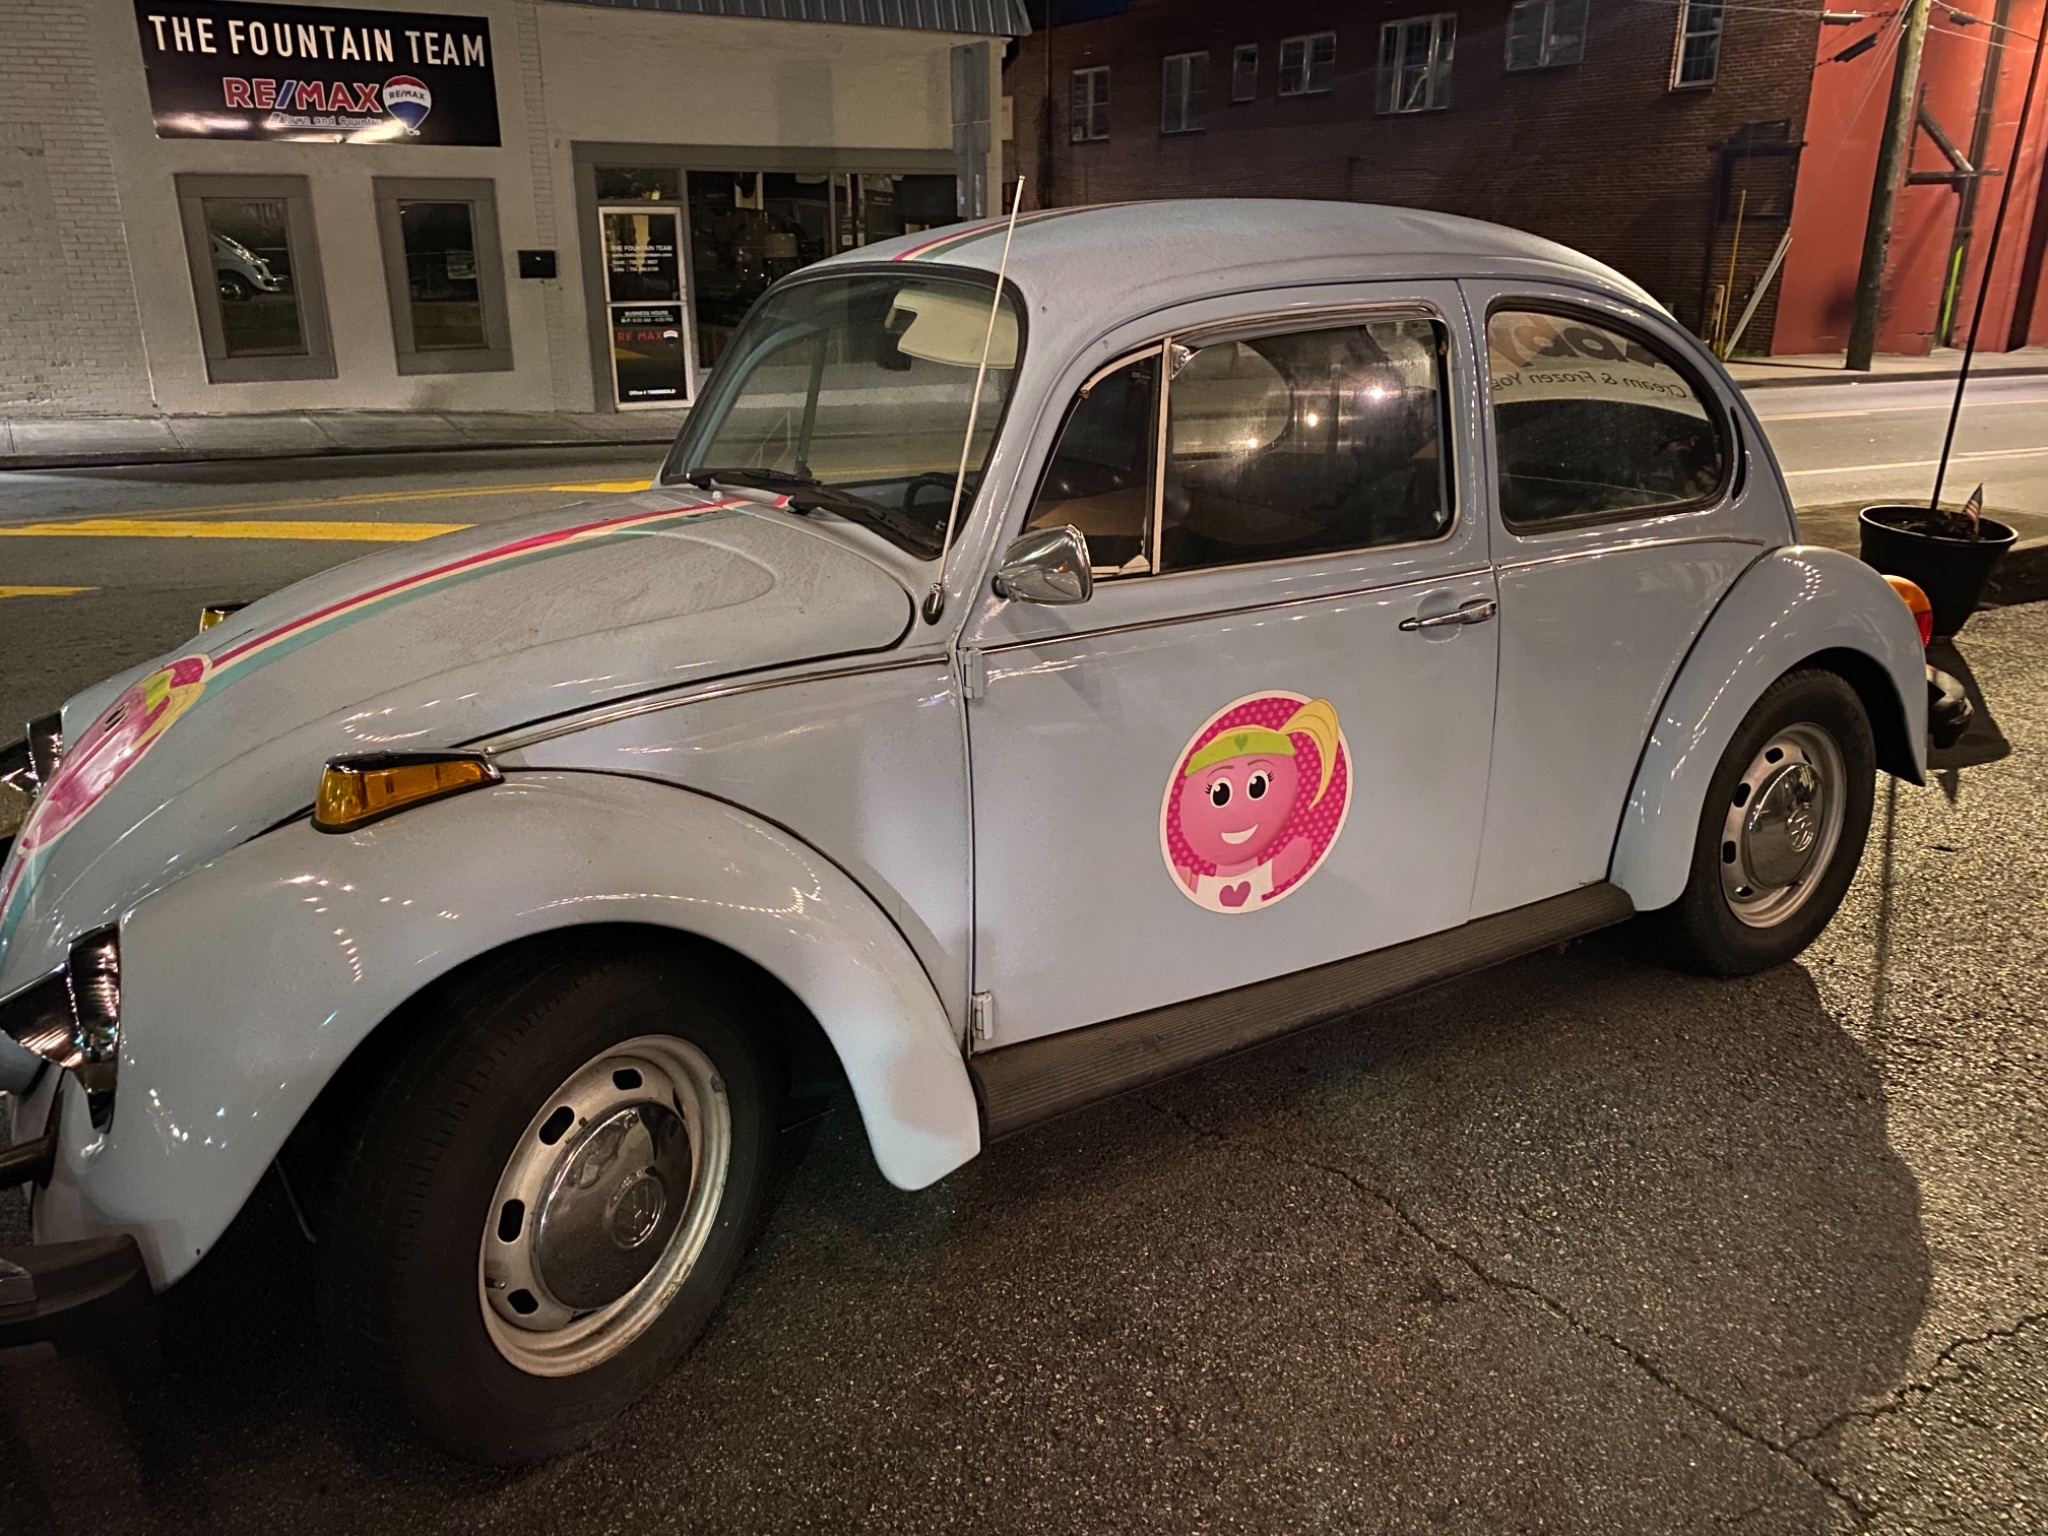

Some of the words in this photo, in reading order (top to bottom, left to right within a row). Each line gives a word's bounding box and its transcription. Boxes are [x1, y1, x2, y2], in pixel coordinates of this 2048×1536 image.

[148, 15, 217, 54] THE
[228, 20, 394, 63] FOUNTAIN
[405, 30, 486, 67] TEAM
[222, 76, 384, 113] RE/MAX
[389, 89, 426, 102] RE/MAX
[313, 115, 336, 126] and
